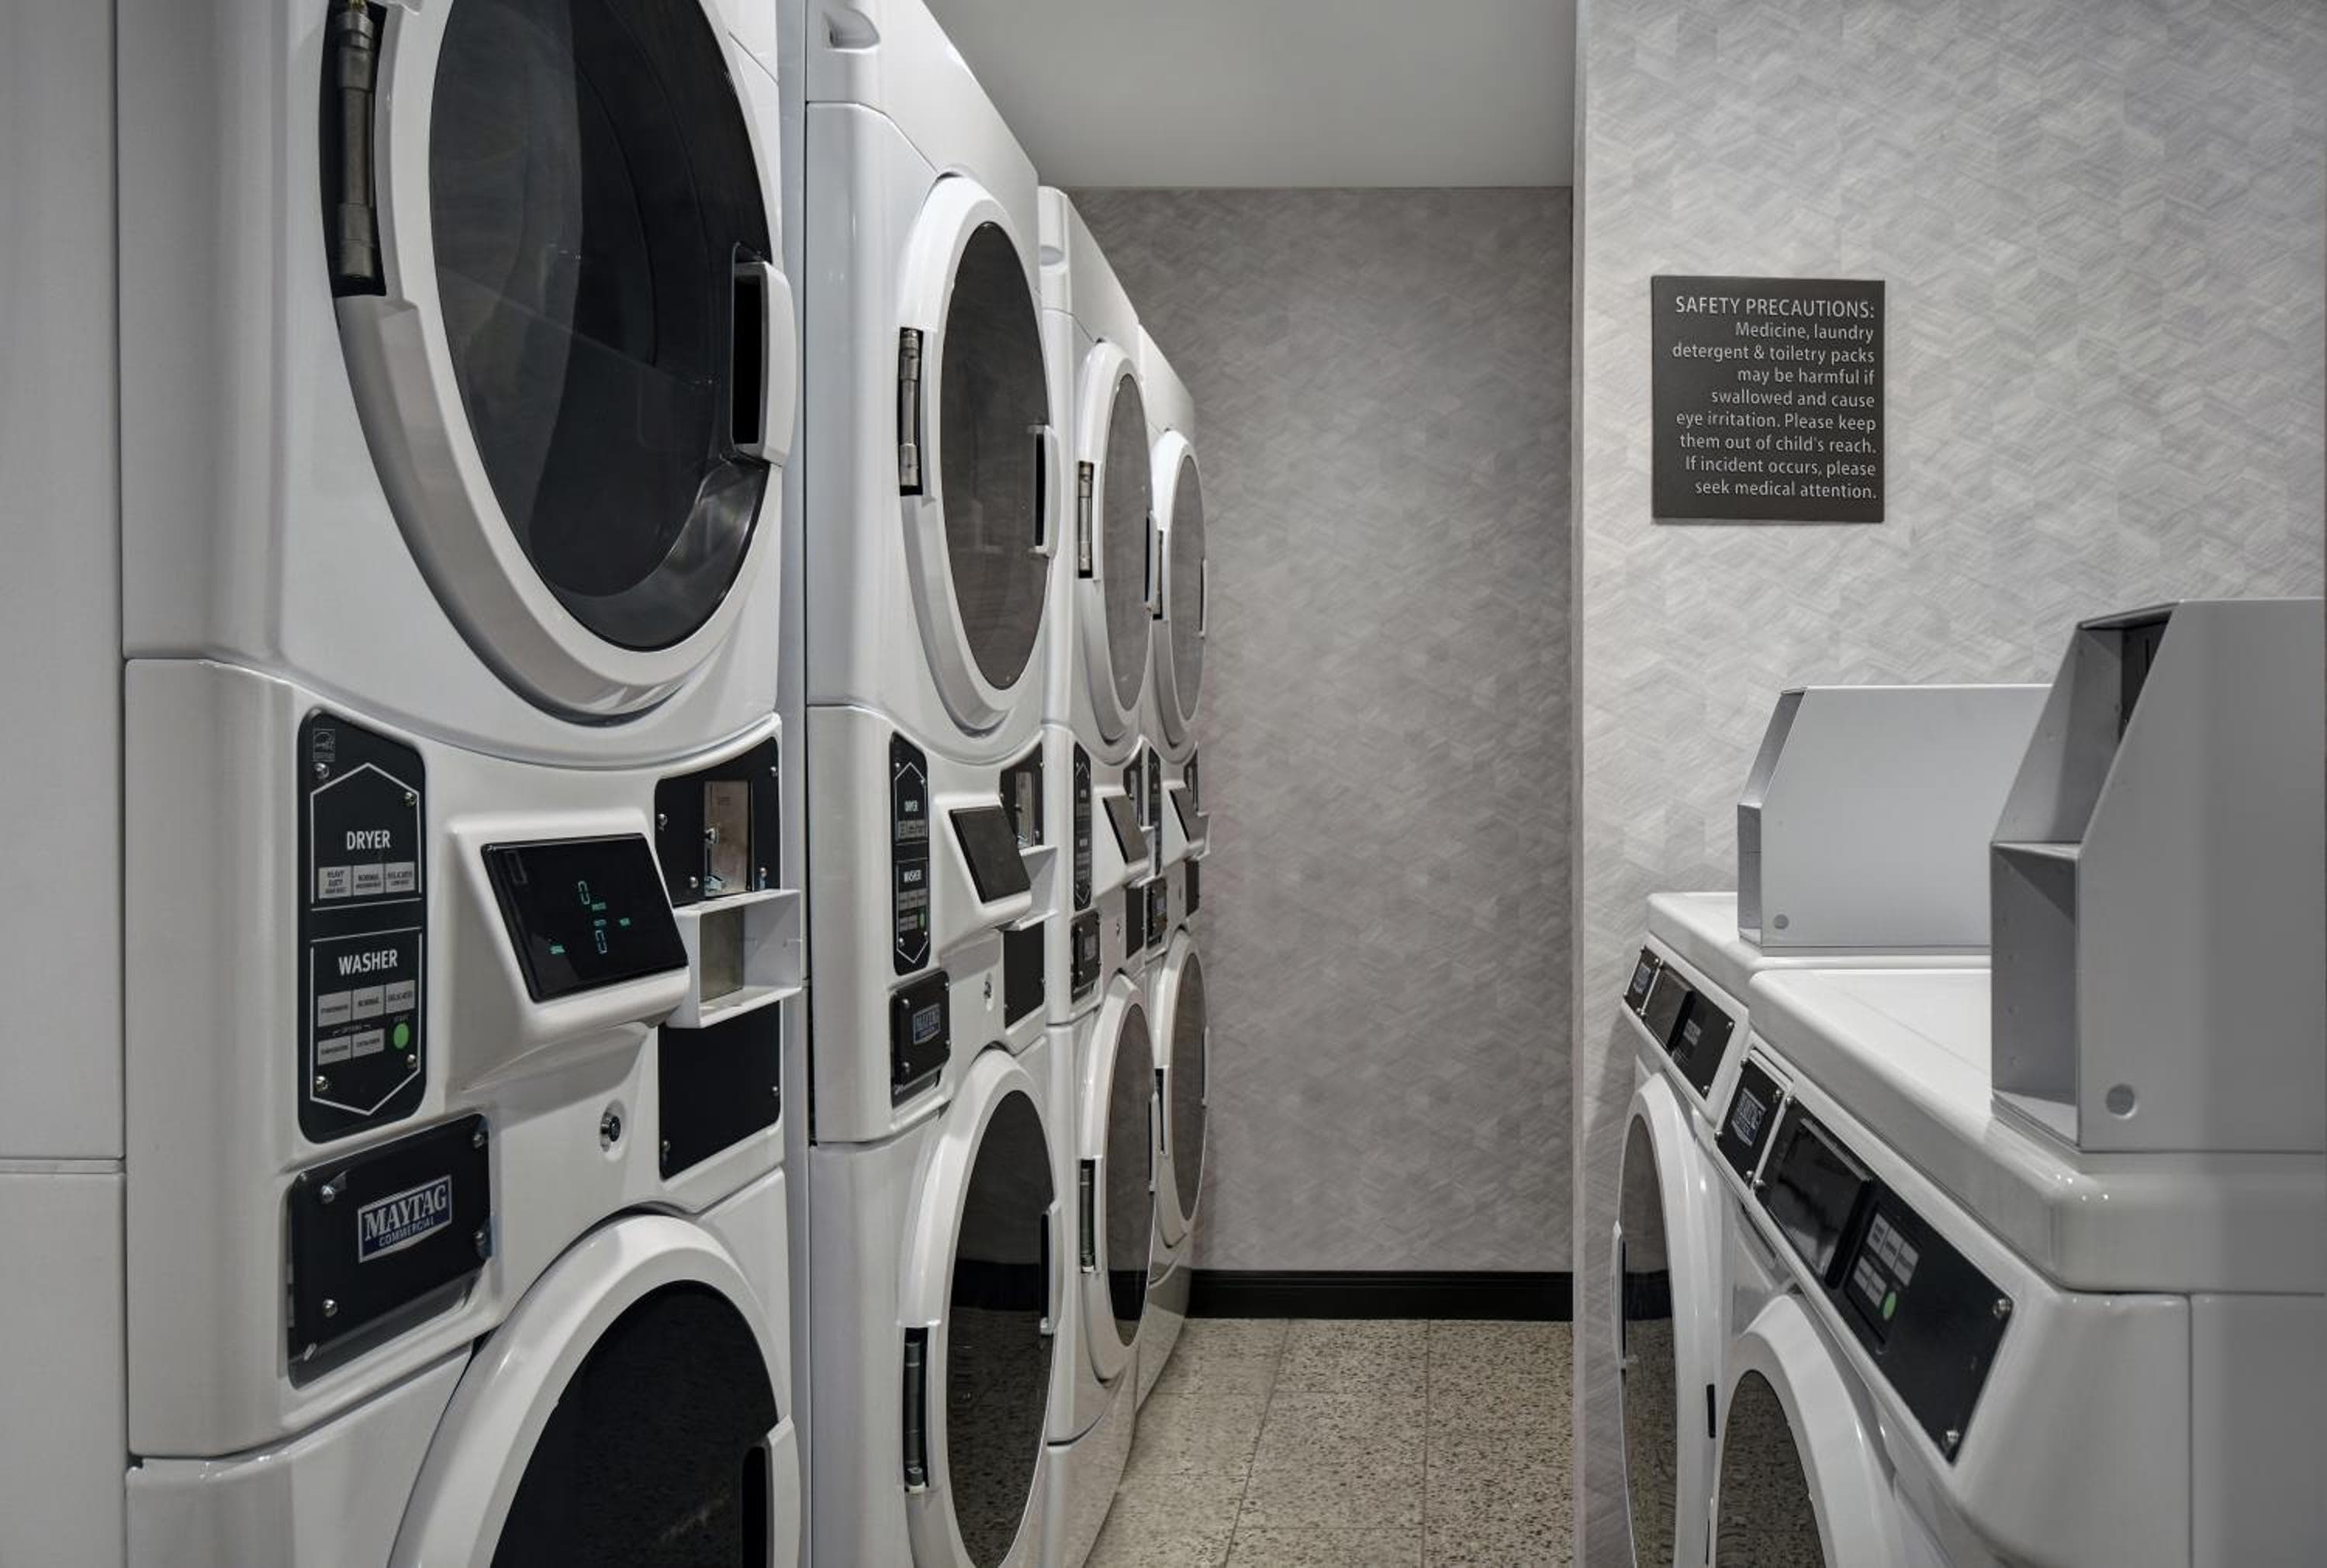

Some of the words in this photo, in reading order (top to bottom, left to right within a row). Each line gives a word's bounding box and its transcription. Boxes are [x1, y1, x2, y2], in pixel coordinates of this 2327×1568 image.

[1676, 296, 1740, 314] SAFETY
[1746, 299, 1874, 318] PRECAUTIONS:
[1736, 322, 1810, 340] Medicine,
[1814, 324, 1873, 344] laundry
[1672, 342, 1748, 362] detergent
[1754, 345, 1764, 360] &
[1770, 345, 1825, 364] toiletry
[1831, 348, 1874, 364] packs
[1737, 369, 1769, 385] may
[1775, 368, 1793, 382] be
[1799, 368, 1859, 385] harmful
[1864, 371, 1874, 385] if
[1713, 390, 1792, 405] swallowed
[1797, 392, 1826, 406] and
[1831, 394, 1874, 407] cause
[1676, 413, 1702, 428] eye
[1708, 411, 1780, 427] irritation.
[1785, 413, 1832, 429] Please
[1839, 415, 1876, 433] keep
[1680, 433, 1719, 447] them
[1725, 437, 1751, 450] out
[1756, 435, 1772, 450] of
[1776, 435, 1824, 451] child's
[1830, 437, 1876, 453] reach.
[1686, 456, 1696, 471] If
[1701, 456, 1762, 472] incident
[1769, 462, 1822, 476] occurs,
[1827, 461, 1876, 478] please
[1695, 479, 1729, 494] seek
[1735, 481, 1795, 496] medical
[1800, 482, 1876, 499] attention.
[347, 830, 391, 850] DRYER
[338, 949, 398, 976] WASHER
[365, 1184, 447, 1241] MAYTAG
